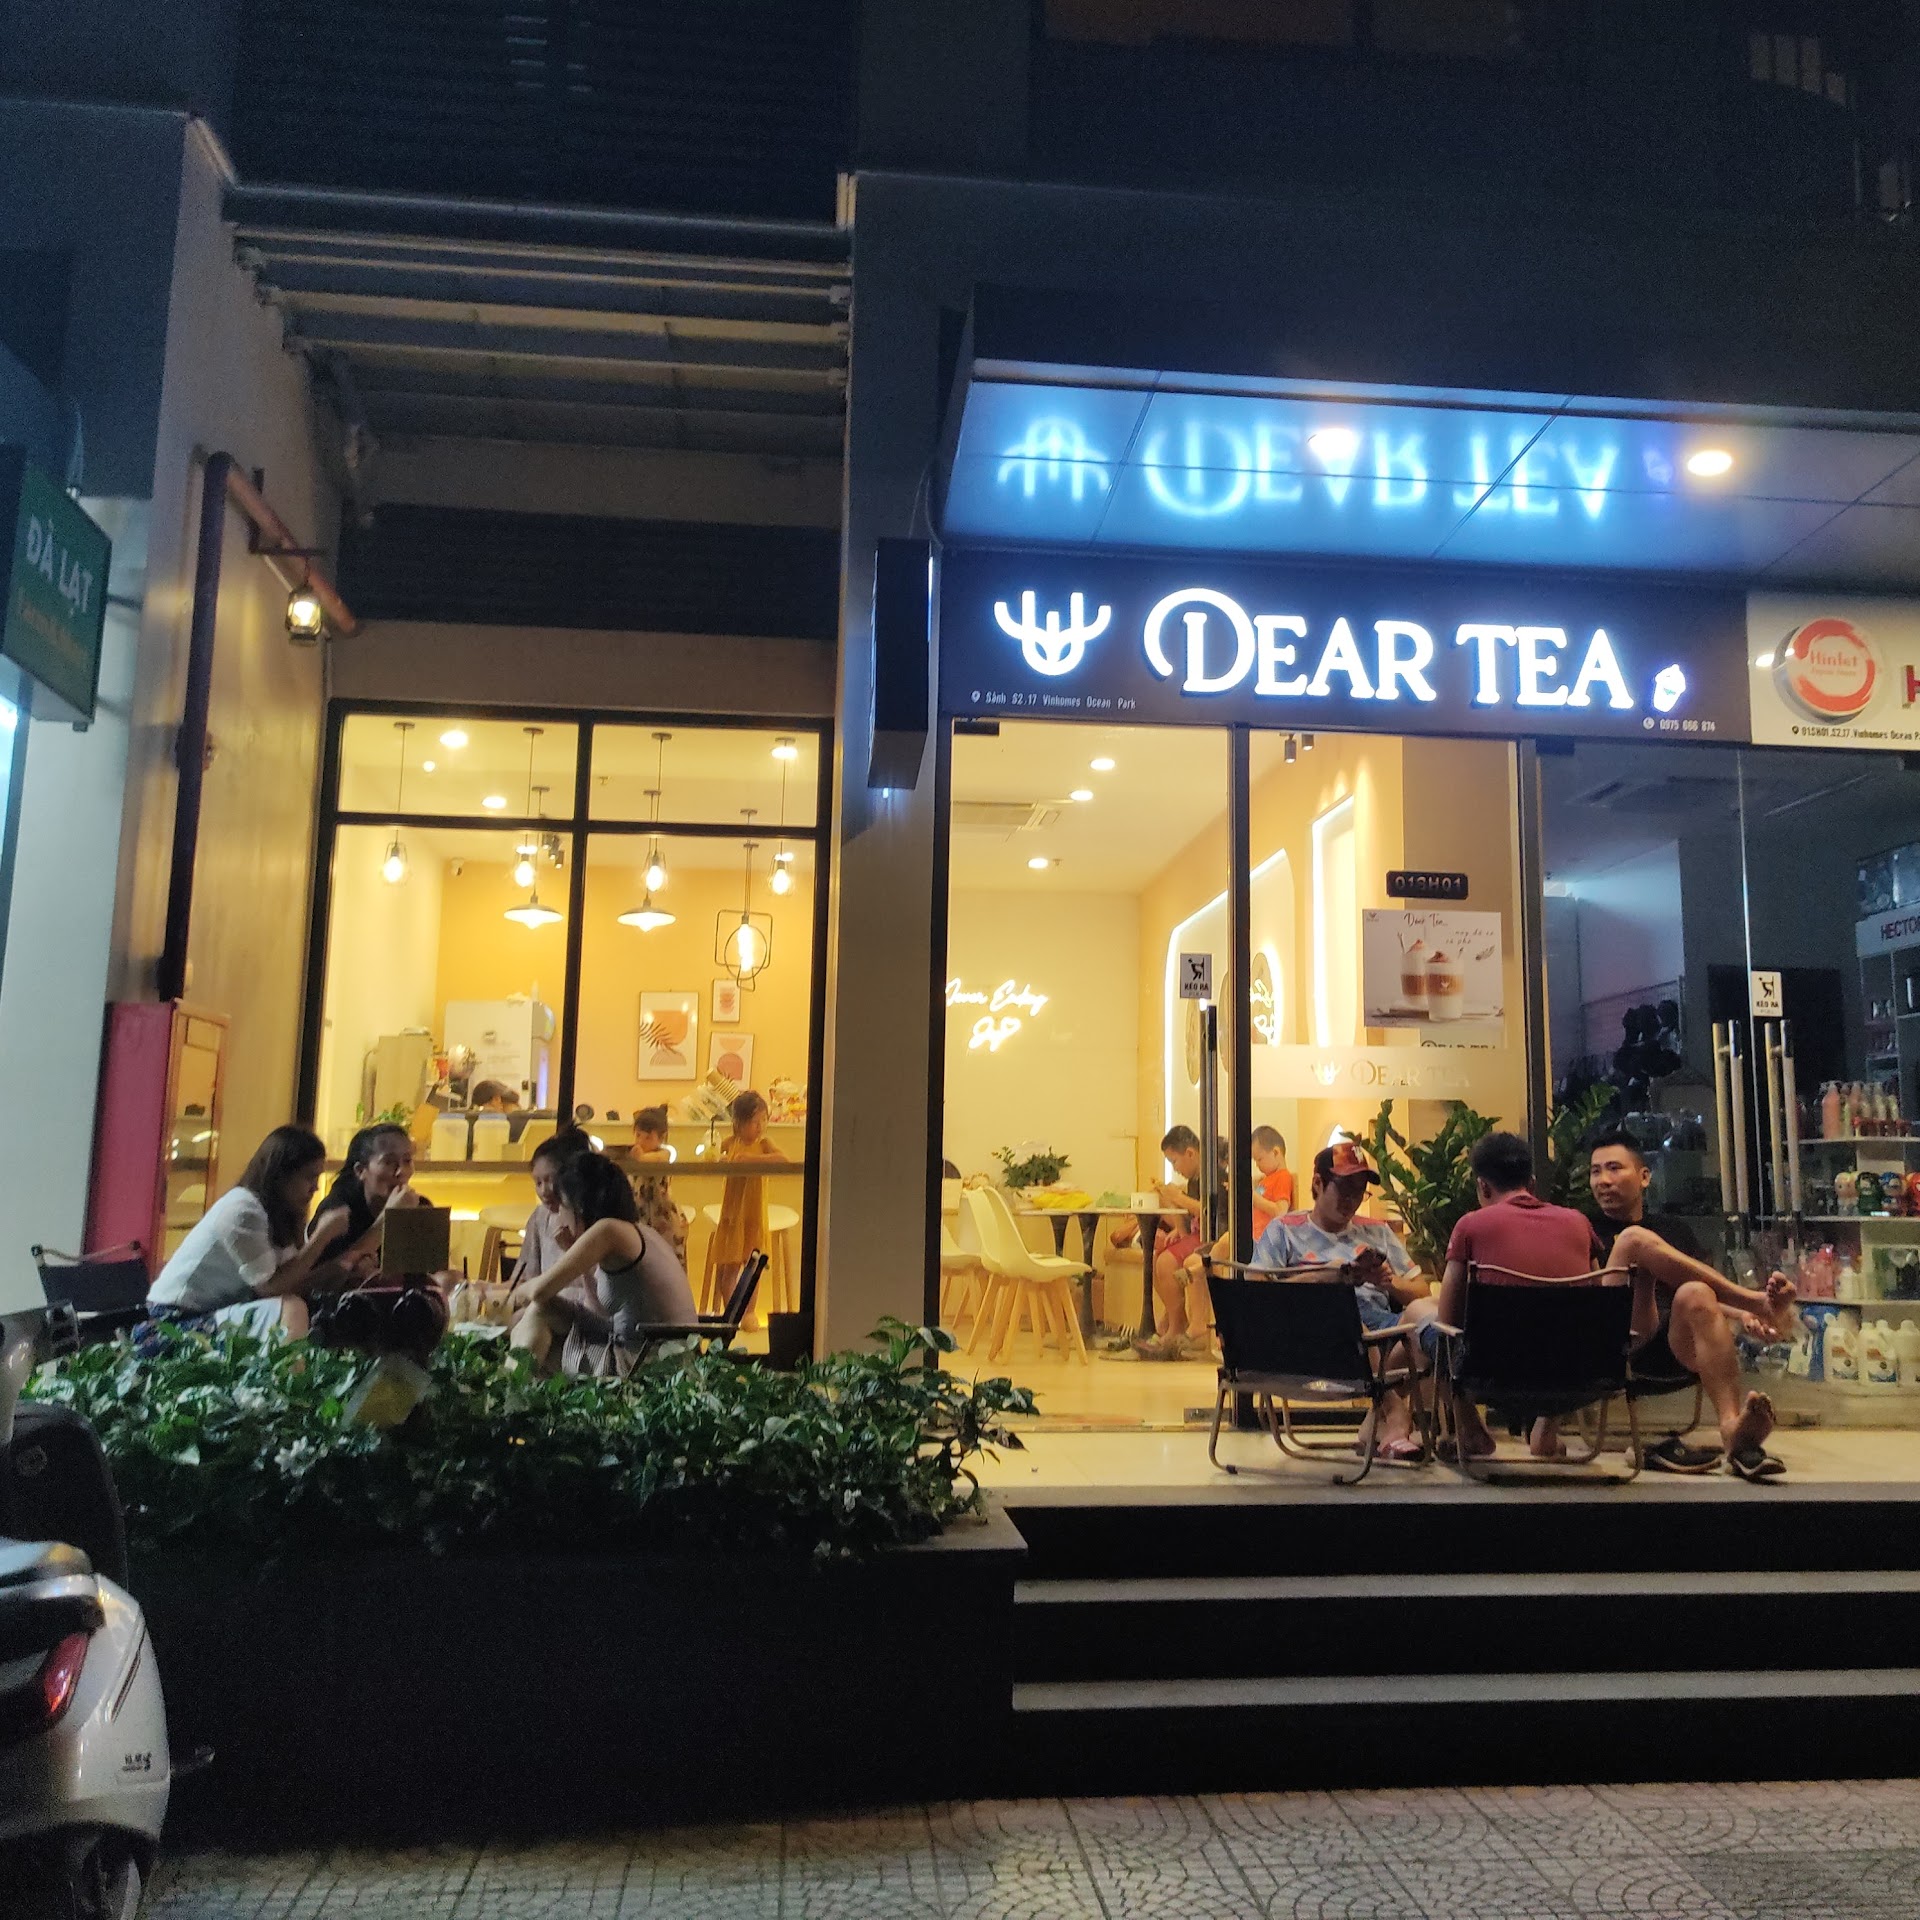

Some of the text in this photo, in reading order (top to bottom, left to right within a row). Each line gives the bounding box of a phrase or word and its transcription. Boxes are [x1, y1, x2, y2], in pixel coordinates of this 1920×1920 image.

[1143, 587, 1634, 709] DEAR TEA
[1043, 694, 1081, 708] Vinhomes
[1087, 695, 1111, 708] Ocean
[1118, 697, 1136, 709] Park
